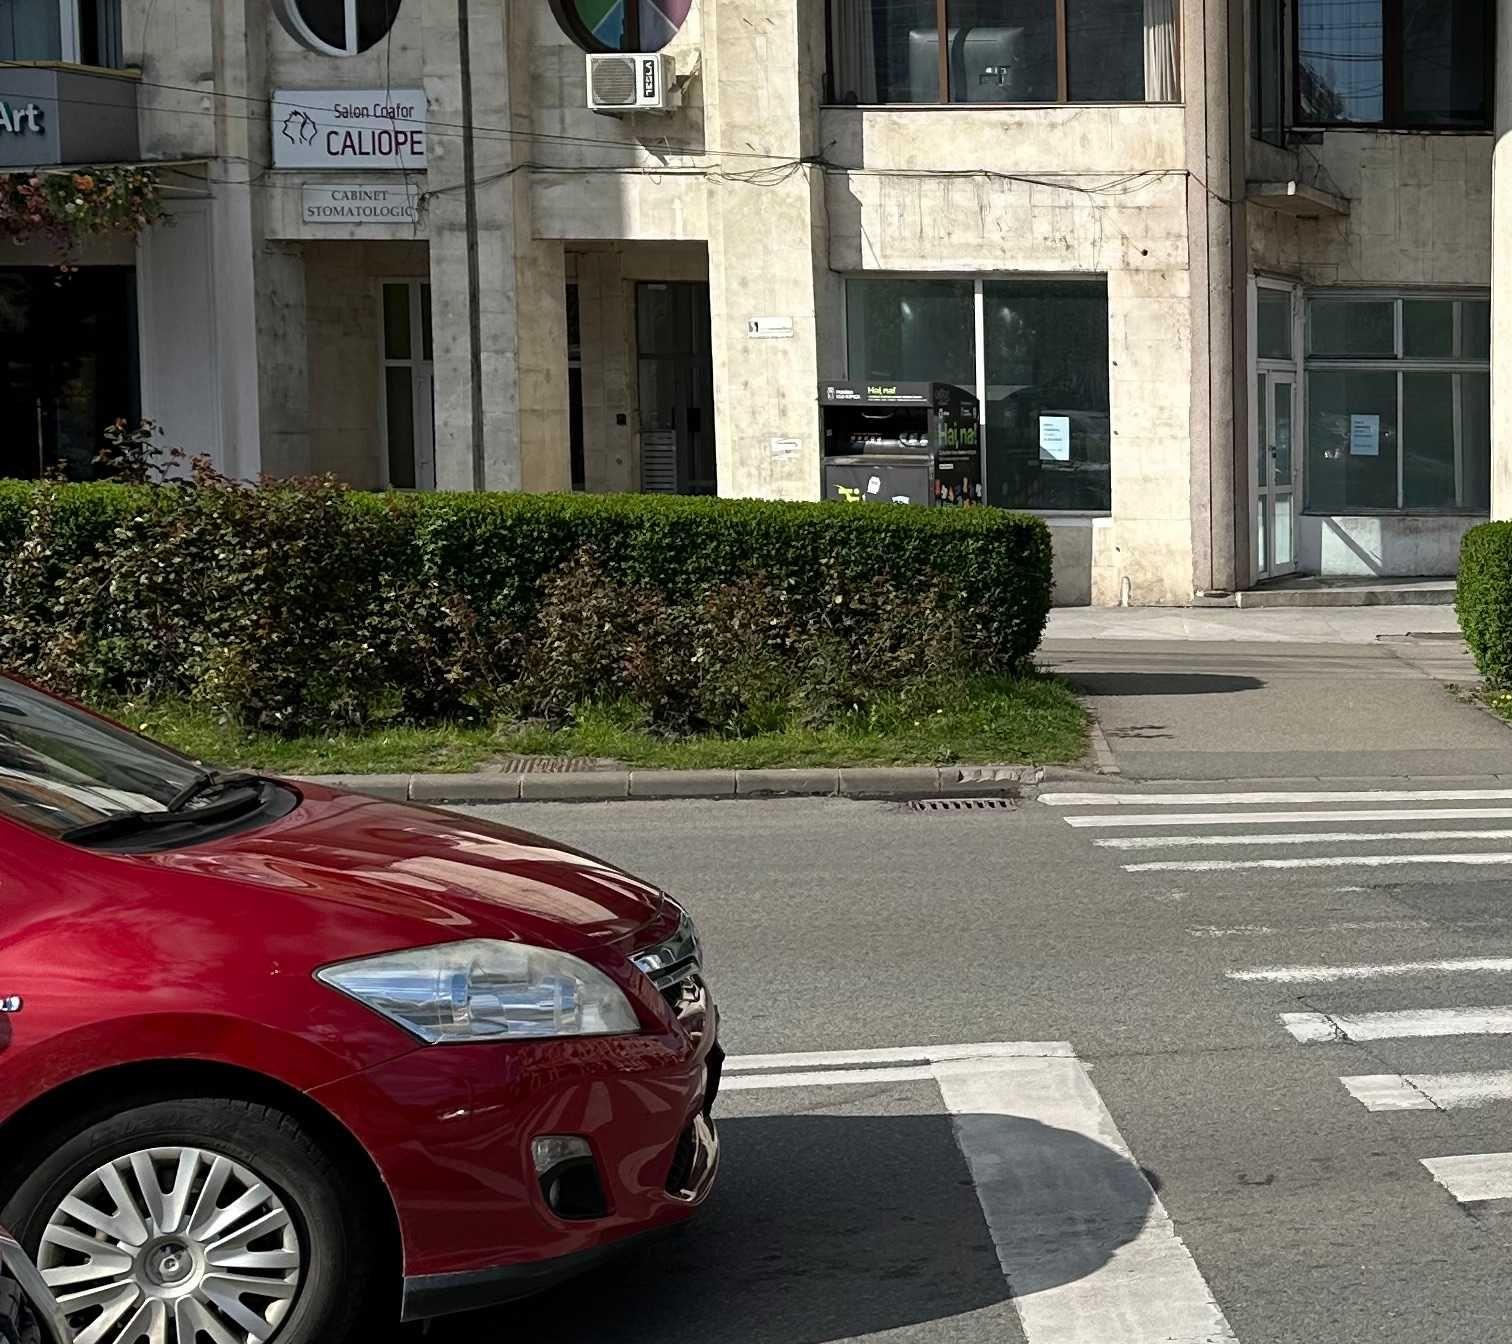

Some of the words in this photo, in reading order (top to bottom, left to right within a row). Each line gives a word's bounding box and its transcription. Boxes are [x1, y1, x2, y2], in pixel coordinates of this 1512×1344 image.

[334, 103, 369, 119] Salon
[373, 103, 415, 119] Coafor
[326, 130, 425, 156] CALIOPE
[331, 190, 389, 202] CABINET
[307, 205, 414, 218] STOMATOLOGIC
